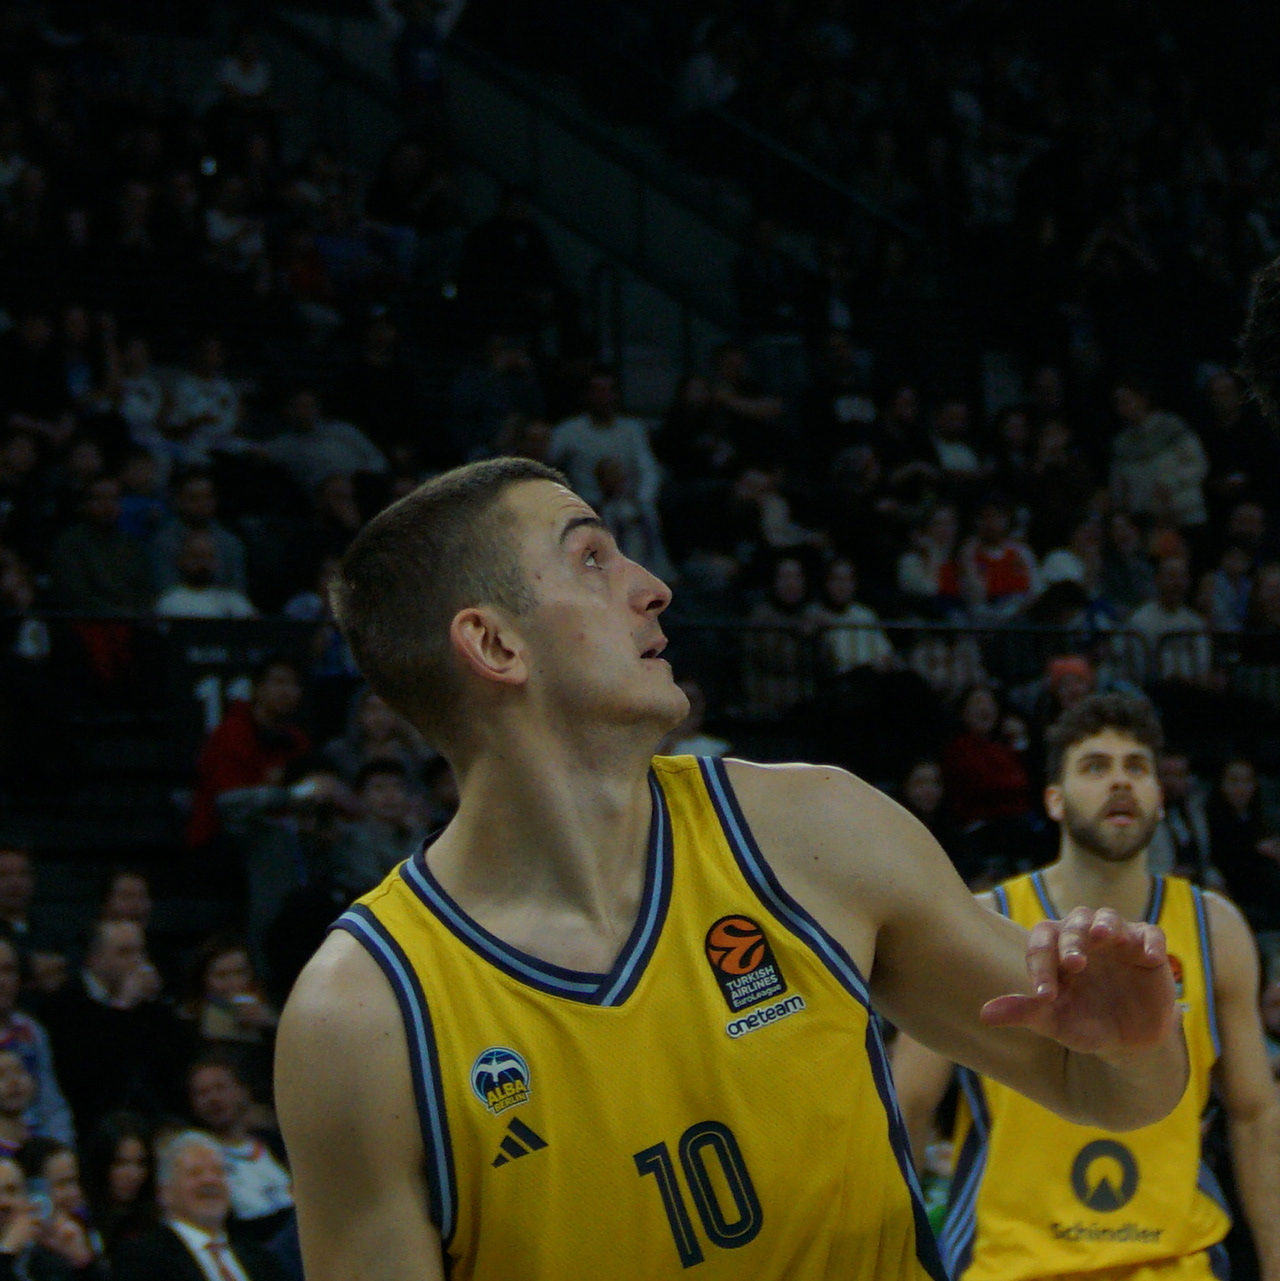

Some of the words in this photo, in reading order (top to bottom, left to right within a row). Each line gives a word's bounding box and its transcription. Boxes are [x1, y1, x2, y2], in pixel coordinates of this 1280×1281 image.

[726, 965, 775, 990] TURKISH
[731, 974, 779, 1000] AIRLINES
[727, 996, 804, 1035] oneteam
[487, 1079, 528, 1107] ALBA
[633, 1120, 763, 1269] 10
